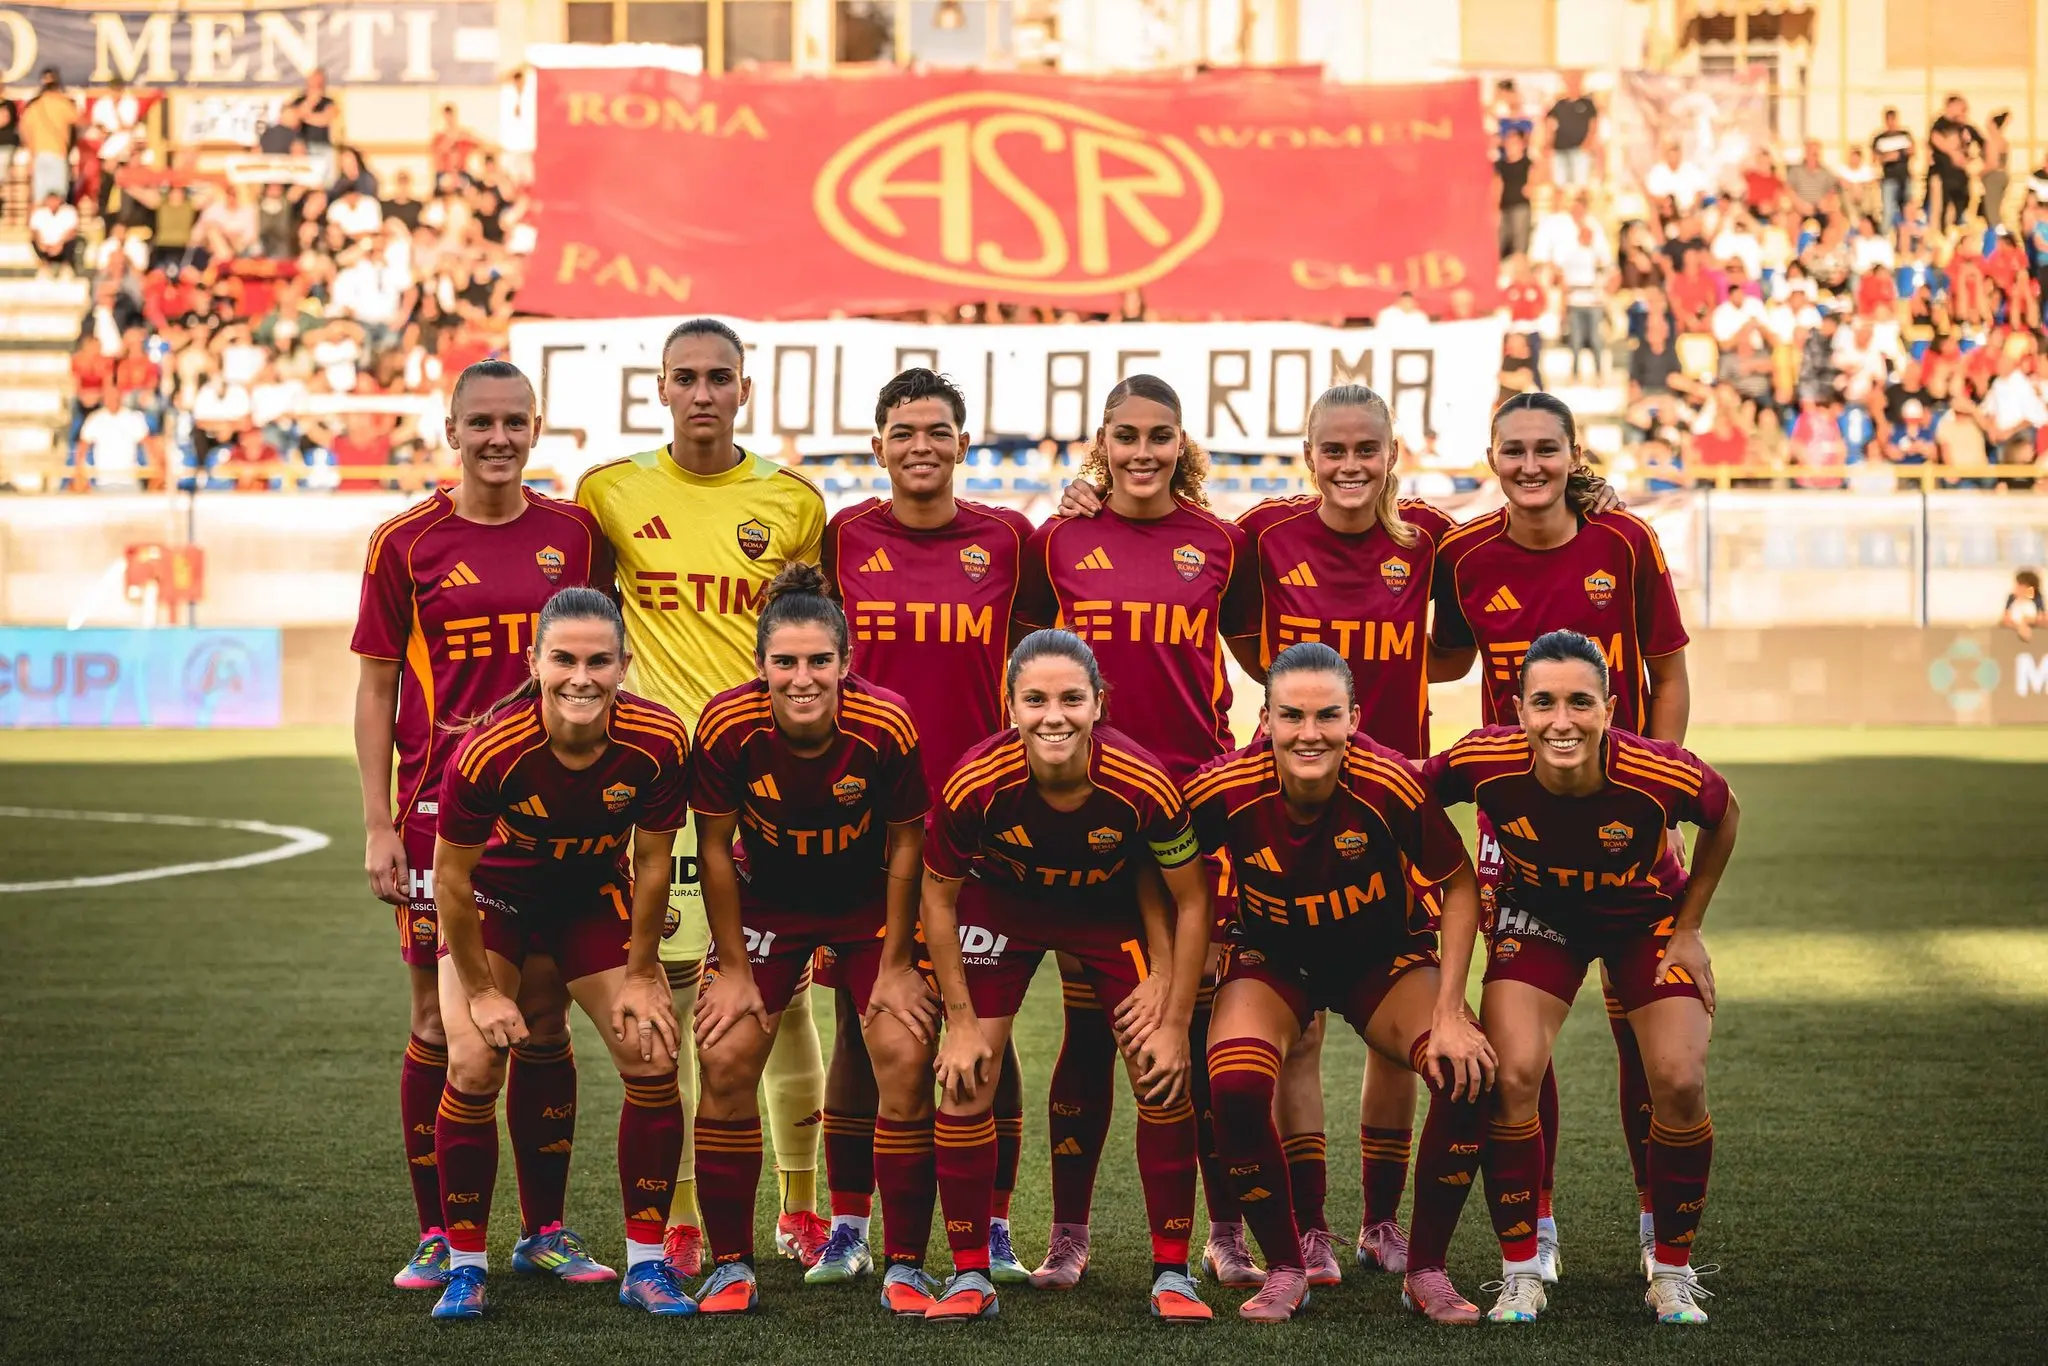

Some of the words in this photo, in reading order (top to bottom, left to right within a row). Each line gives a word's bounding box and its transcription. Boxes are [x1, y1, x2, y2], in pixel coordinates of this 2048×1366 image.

[88, 8, 440, 84] MENTI
[567, 92, 768, 140] ROMA
[849, 113, 1186, 278] ASR
[556, 242, 694, 302] FAN
[743, 541, 764, 549] ROMA
[965, 564, 986, 573] ROMA
[1177, 564, 1200, 572] ROMA
[687, 573, 771, 615] TIM
[1590, 592, 1613, 600] ROMA
[906, 602, 993, 645] TIM
[1122, 601, 1209, 648] TIM
[498, 612, 540, 654] TI
[1331, 620, 1415, 661] TIM
[0, 653, 119, 699] UP
[607, 800, 630, 811] ROMA
[838, 793, 863, 803] ROMA
[787, 807, 873, 856] TIM
[547, 826, 631, 861] TIM
[1092, 843, 1117, 851] ROMA
[1341, 846, 1366, 857] ROMA
[1036, 857, 1127, 887] TIM
[1547, 861, 1641, 892] TIM
[1295, 871, 1387, 926] TIM
[542, 1102, 574, 1120] ASR
[1052, 1101, 1082, 1117] ASR
[413, 1123, 437, 1135] AS
[1448, 1143, 1480, 1155] ASR
[1229, 1164, 1261, 1176] ASR
[636, 1177, 668, 1192] ASR
[447, 1192, 480, 1204] ASR
[1501, 1190, 1531, 1204] ASR
[1676, 1196, 1706, 1213] ASR
[947, 1220, 973, 1233] ASR
[1164, 1217, 1191, 1230] ASR
